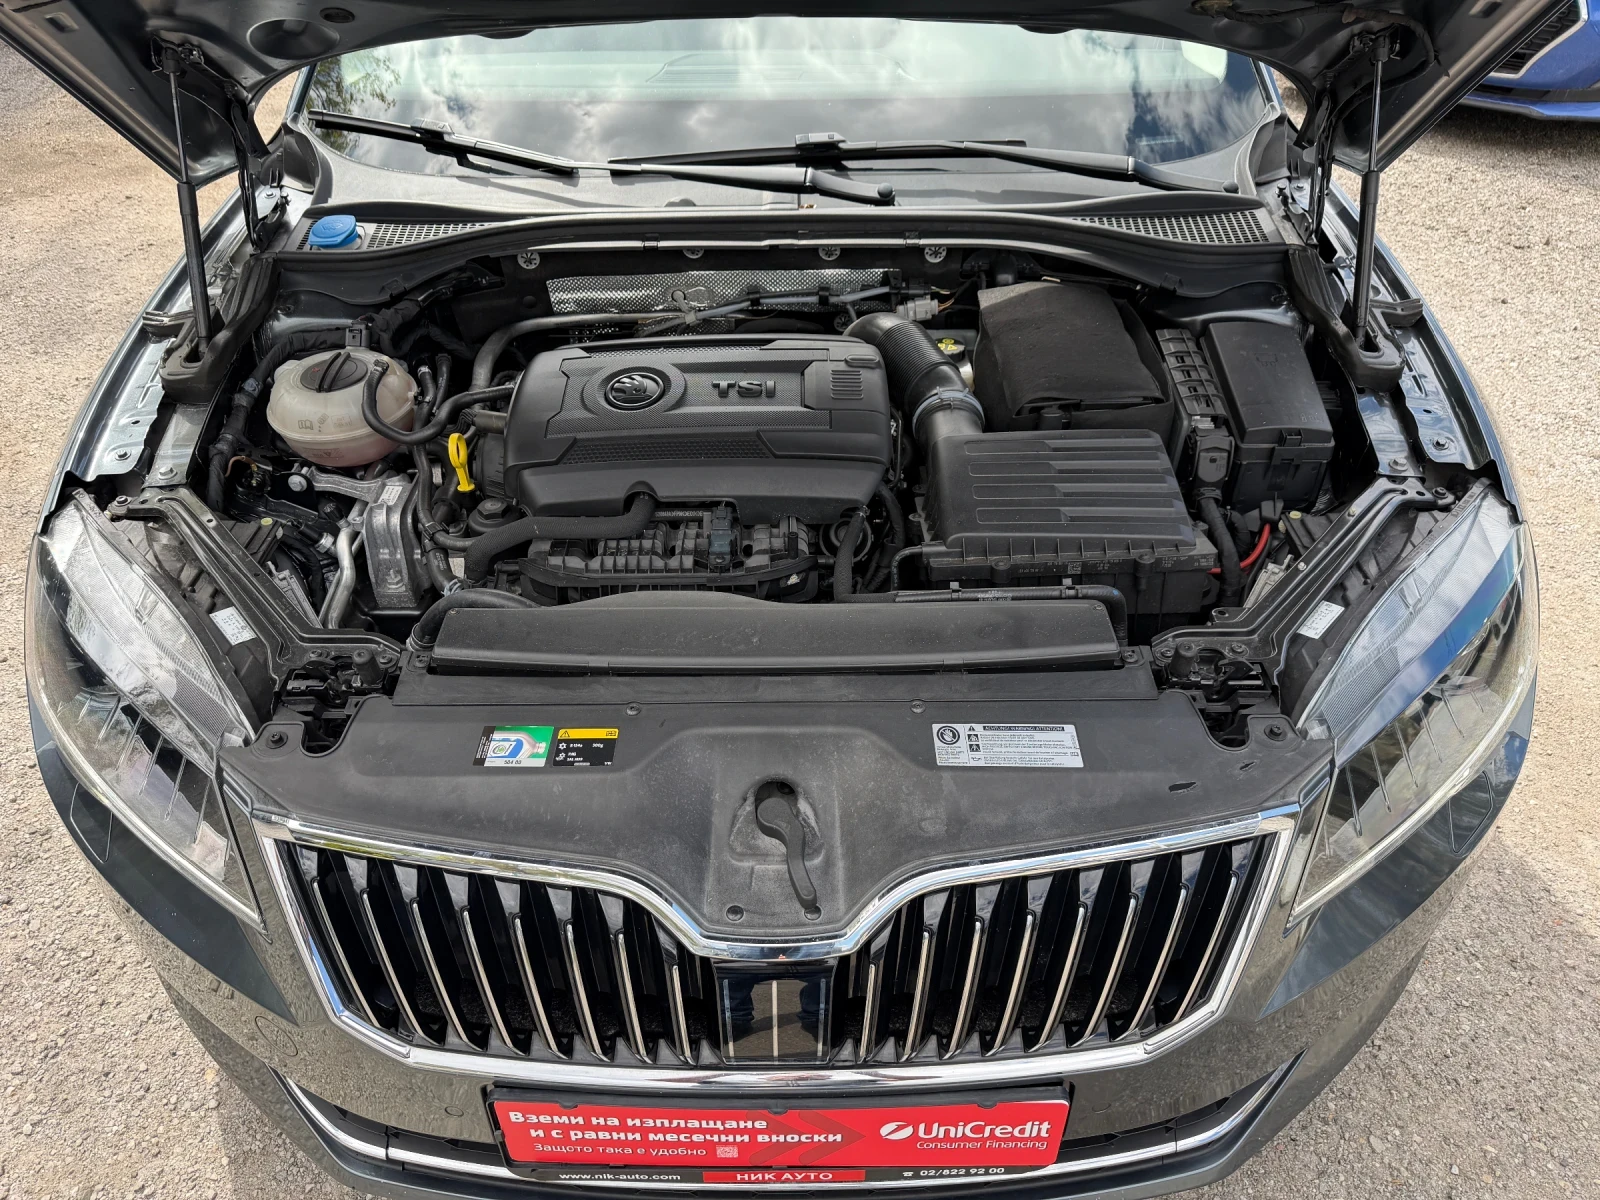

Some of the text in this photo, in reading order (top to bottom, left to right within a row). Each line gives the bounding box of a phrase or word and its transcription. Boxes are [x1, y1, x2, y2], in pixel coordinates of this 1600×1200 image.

[711, 380, 776, 398] TSI
[508, 1111, 768, 1130] Вземи на изплащане
[529, 1128, 842, 1143] и с равни месечни вноски
[917, 1121, 1052, 1138] UniCredit
[533, 1143, 707, 1157] Защото така е удобно
[916, 1139, 1048, 1150] Consumer Financing
[559, 1172, 681, 1180] www.nik-auto.com
[736, 1172, 833, 1181] НИК АУТО
[920, 1168, 966, 1177] 02/822
